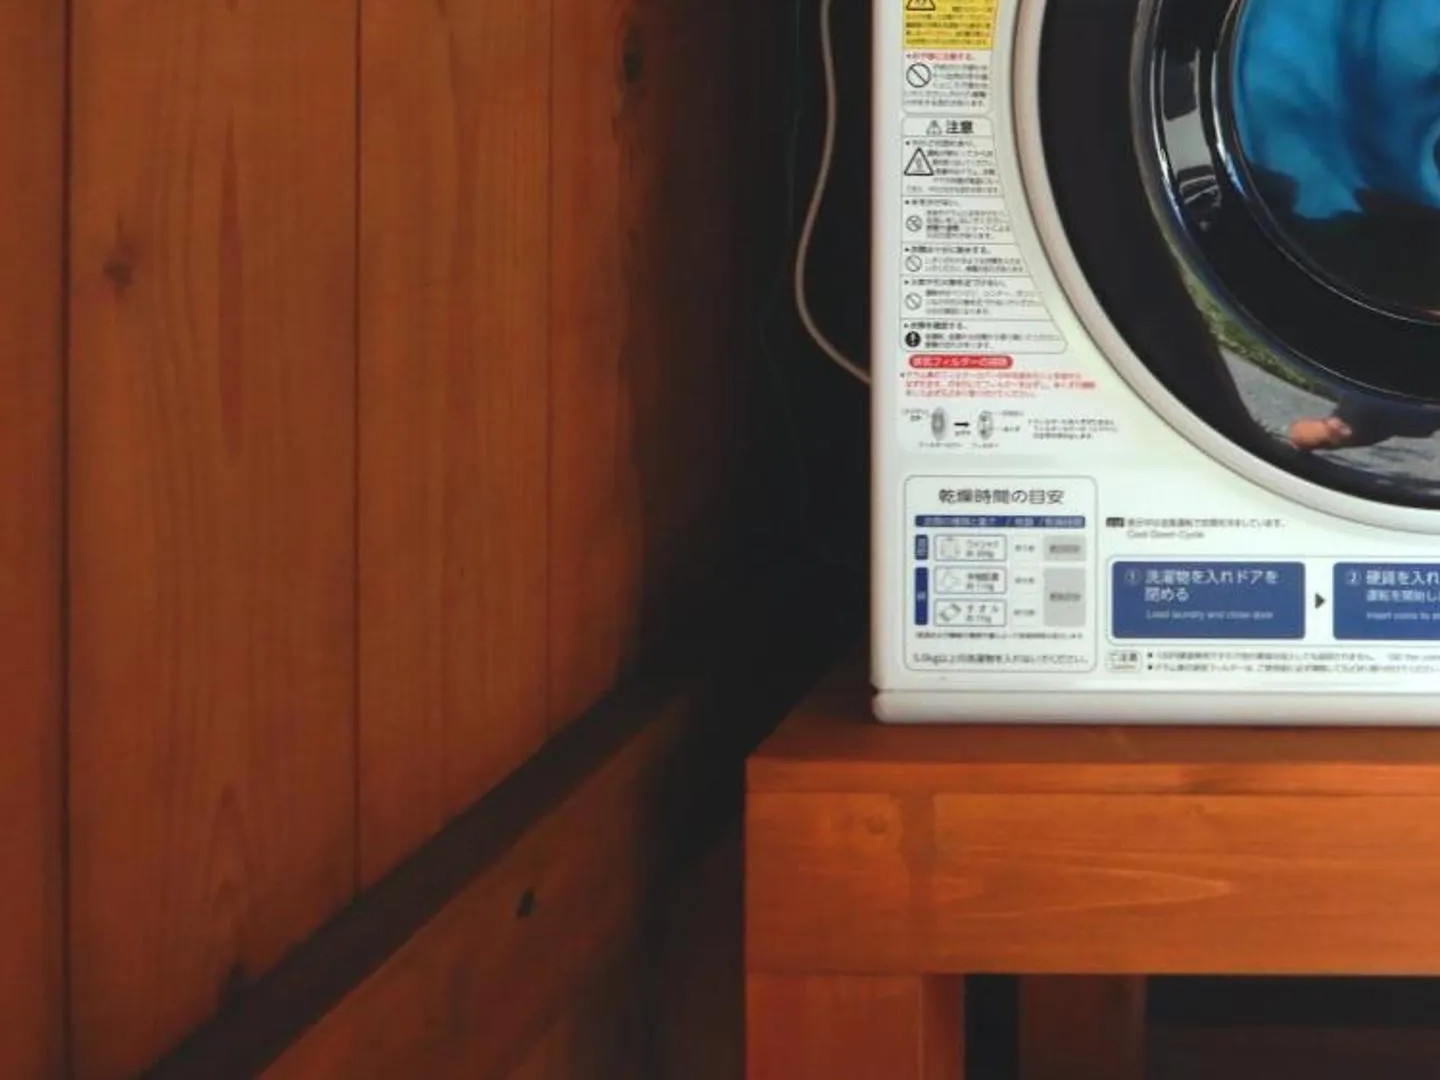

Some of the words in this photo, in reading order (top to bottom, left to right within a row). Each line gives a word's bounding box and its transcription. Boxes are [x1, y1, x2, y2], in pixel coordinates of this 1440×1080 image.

[946, 120, 974, 134] 注意
[938, 488, 1065, 505] 乾燥時間の目安
[1144, 569, 1280, 585] 洗濯物を入れドアを
[1144, 587, 1190, 603] 閉める
